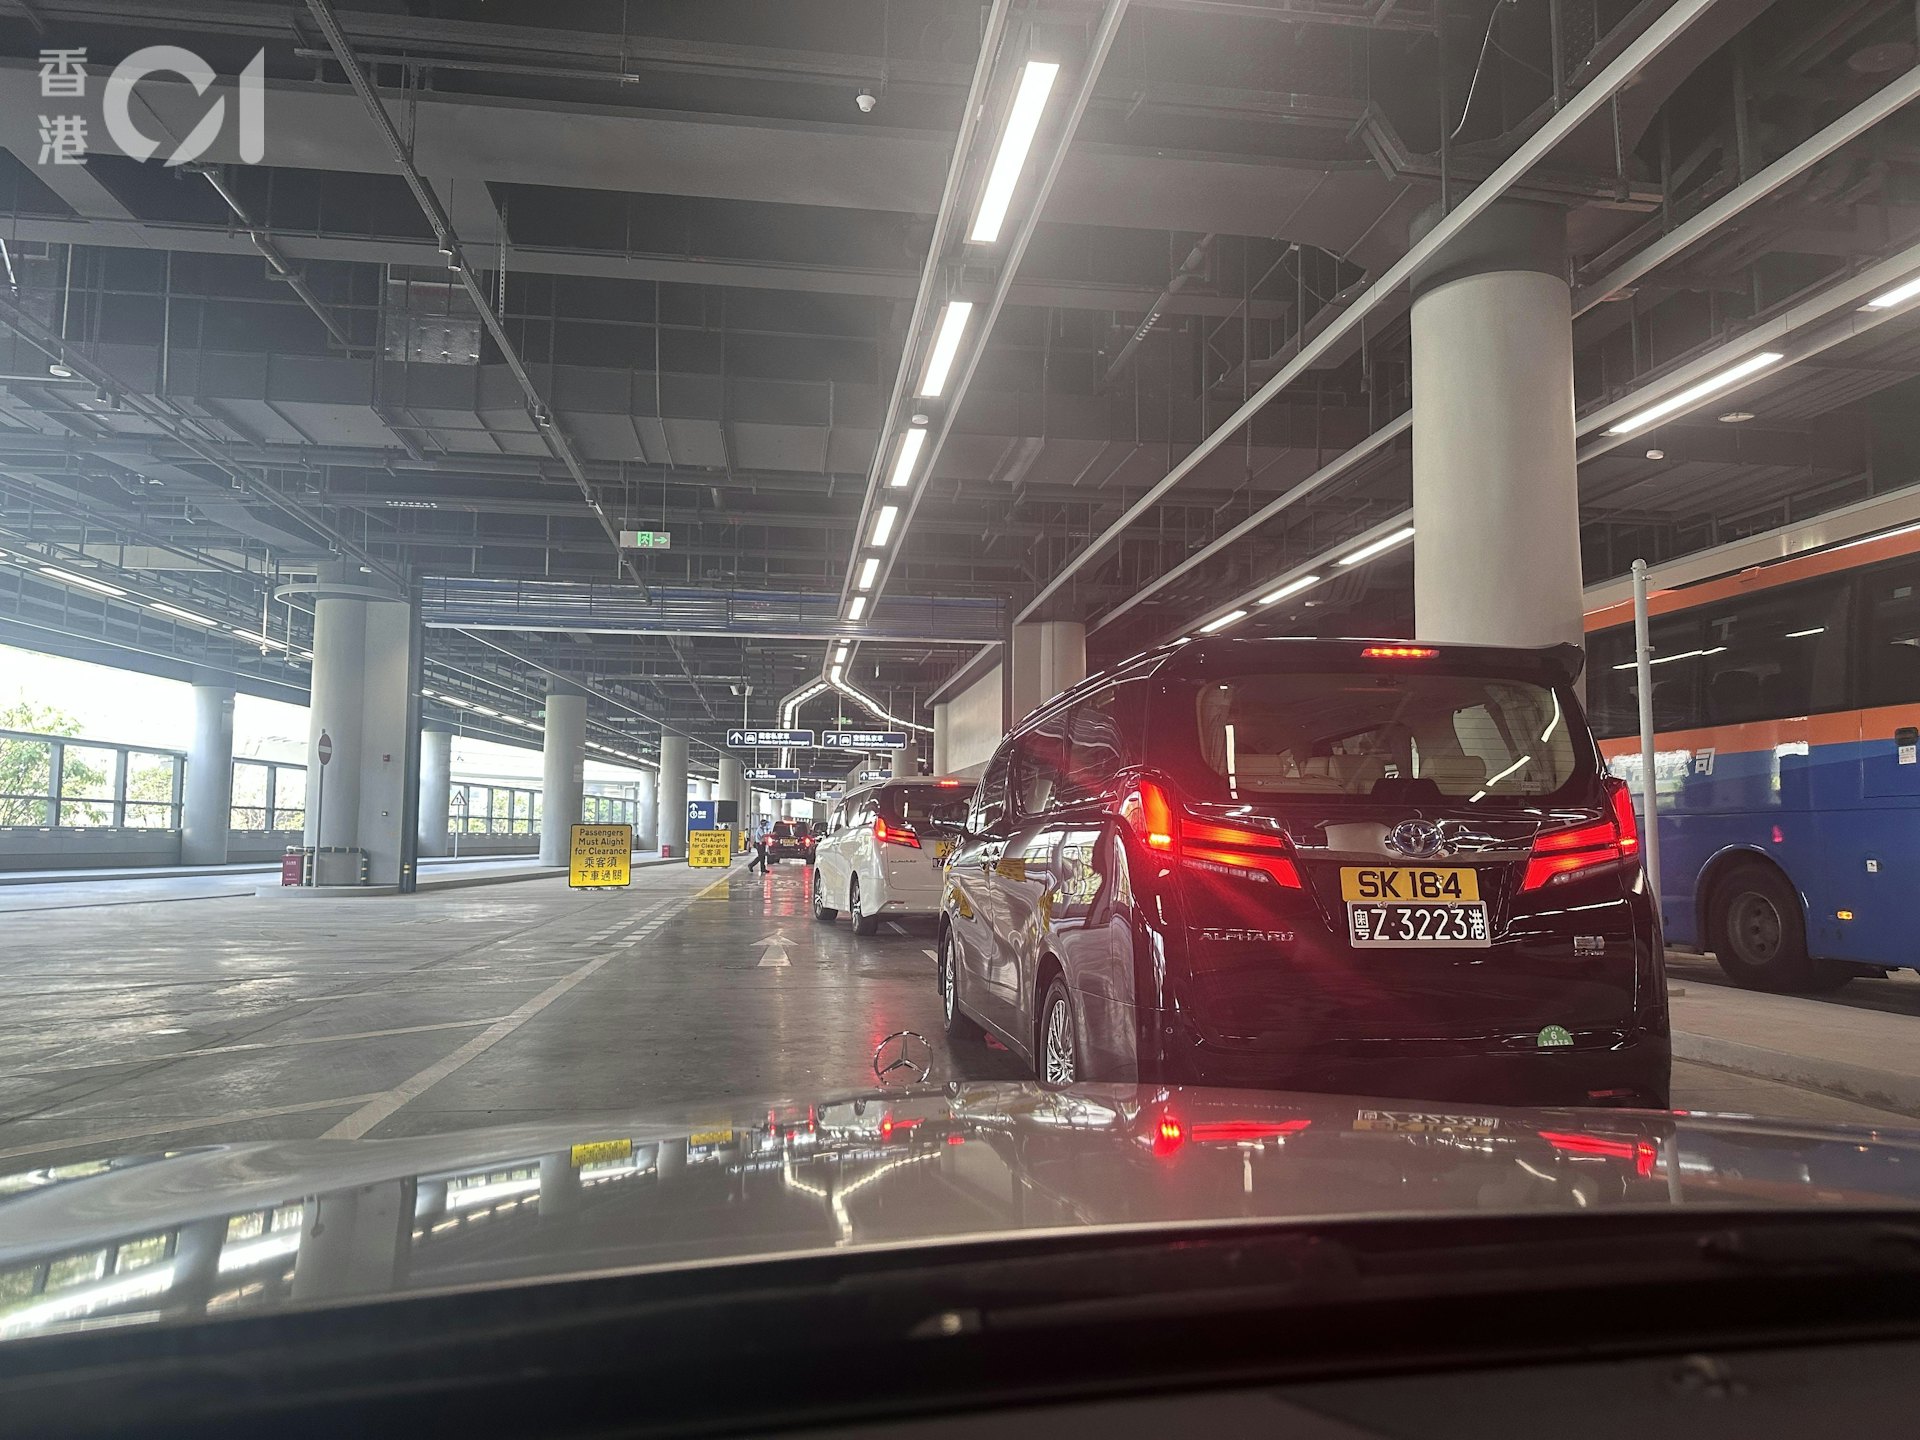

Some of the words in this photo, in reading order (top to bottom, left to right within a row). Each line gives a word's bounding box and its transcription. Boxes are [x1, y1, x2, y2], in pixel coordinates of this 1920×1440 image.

[580, 829, 624, 837] Passengers
[601, 838, 624, 846] Alight
[575, 847, 586, 855] for
[589, 847, 627, 855] Clearance
[585, 857, 617, 868] 乘客須
[578, 870, 622, 881] 下車過關
[1358, 871, 1401, 898] SK
[1409, 871, 1462, 898] 184
[1199, 931, 1294, 941] ALPHARD
[1550, 1031, 1558, 1040] 6
